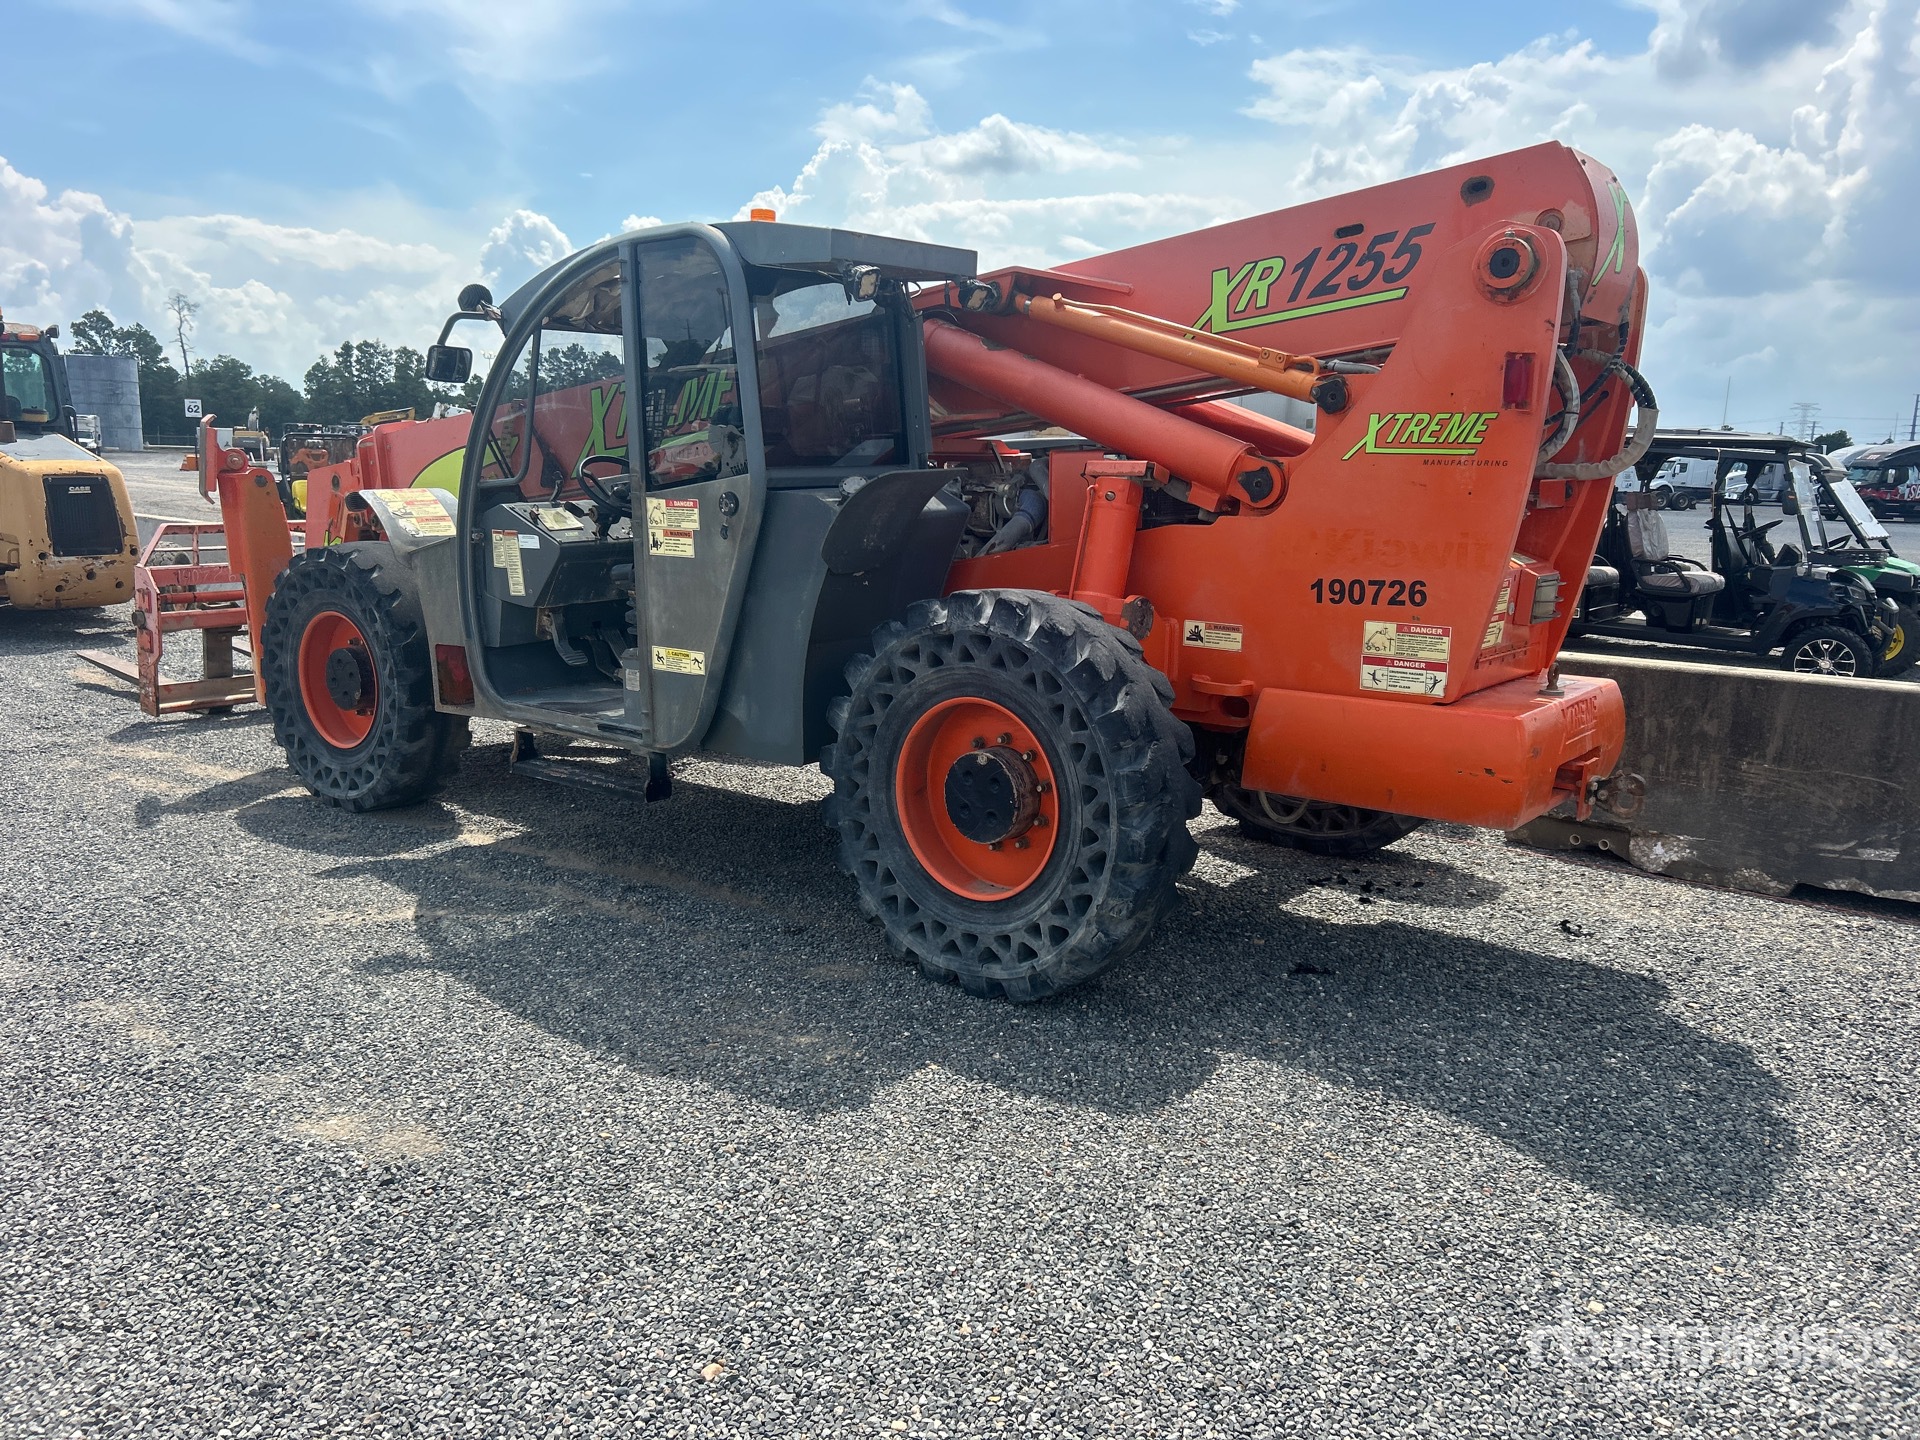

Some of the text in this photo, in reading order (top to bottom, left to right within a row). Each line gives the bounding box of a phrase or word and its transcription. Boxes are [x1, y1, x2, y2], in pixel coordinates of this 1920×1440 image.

[1184, 222, 1437, 338] XR 1255
[187, 404, 200, 414] 62
[1341, 412, 1499, 461] XTREME
[1423, 459, 1508, 467] MANUFACTURING
[1310, 578, 1427, 607] 190726
[1410, 626, 1443, 635] DANGER
[1393, 660, 1426, 668] DANGER
